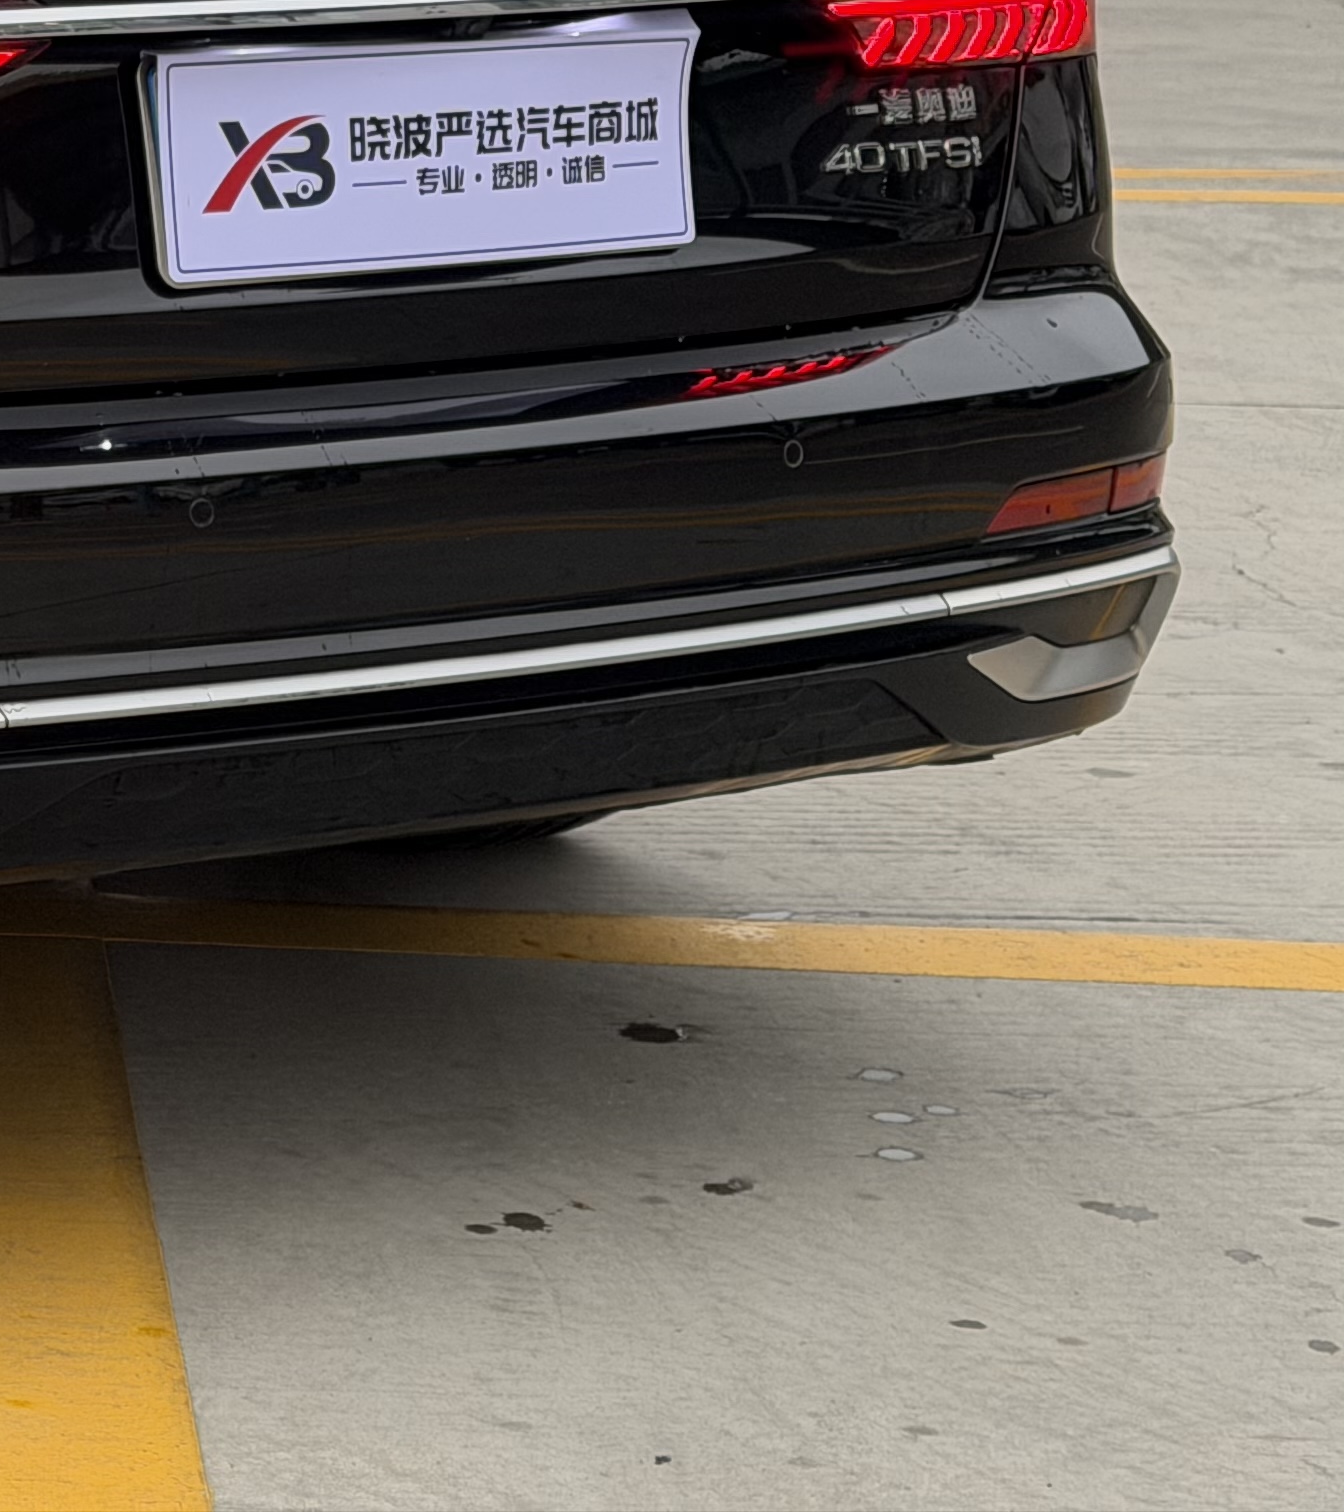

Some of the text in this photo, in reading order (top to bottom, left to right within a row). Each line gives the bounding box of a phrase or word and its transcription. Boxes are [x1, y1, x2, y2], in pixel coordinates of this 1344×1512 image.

[349, 98, 659, 163] 晓波严选汽车商城
